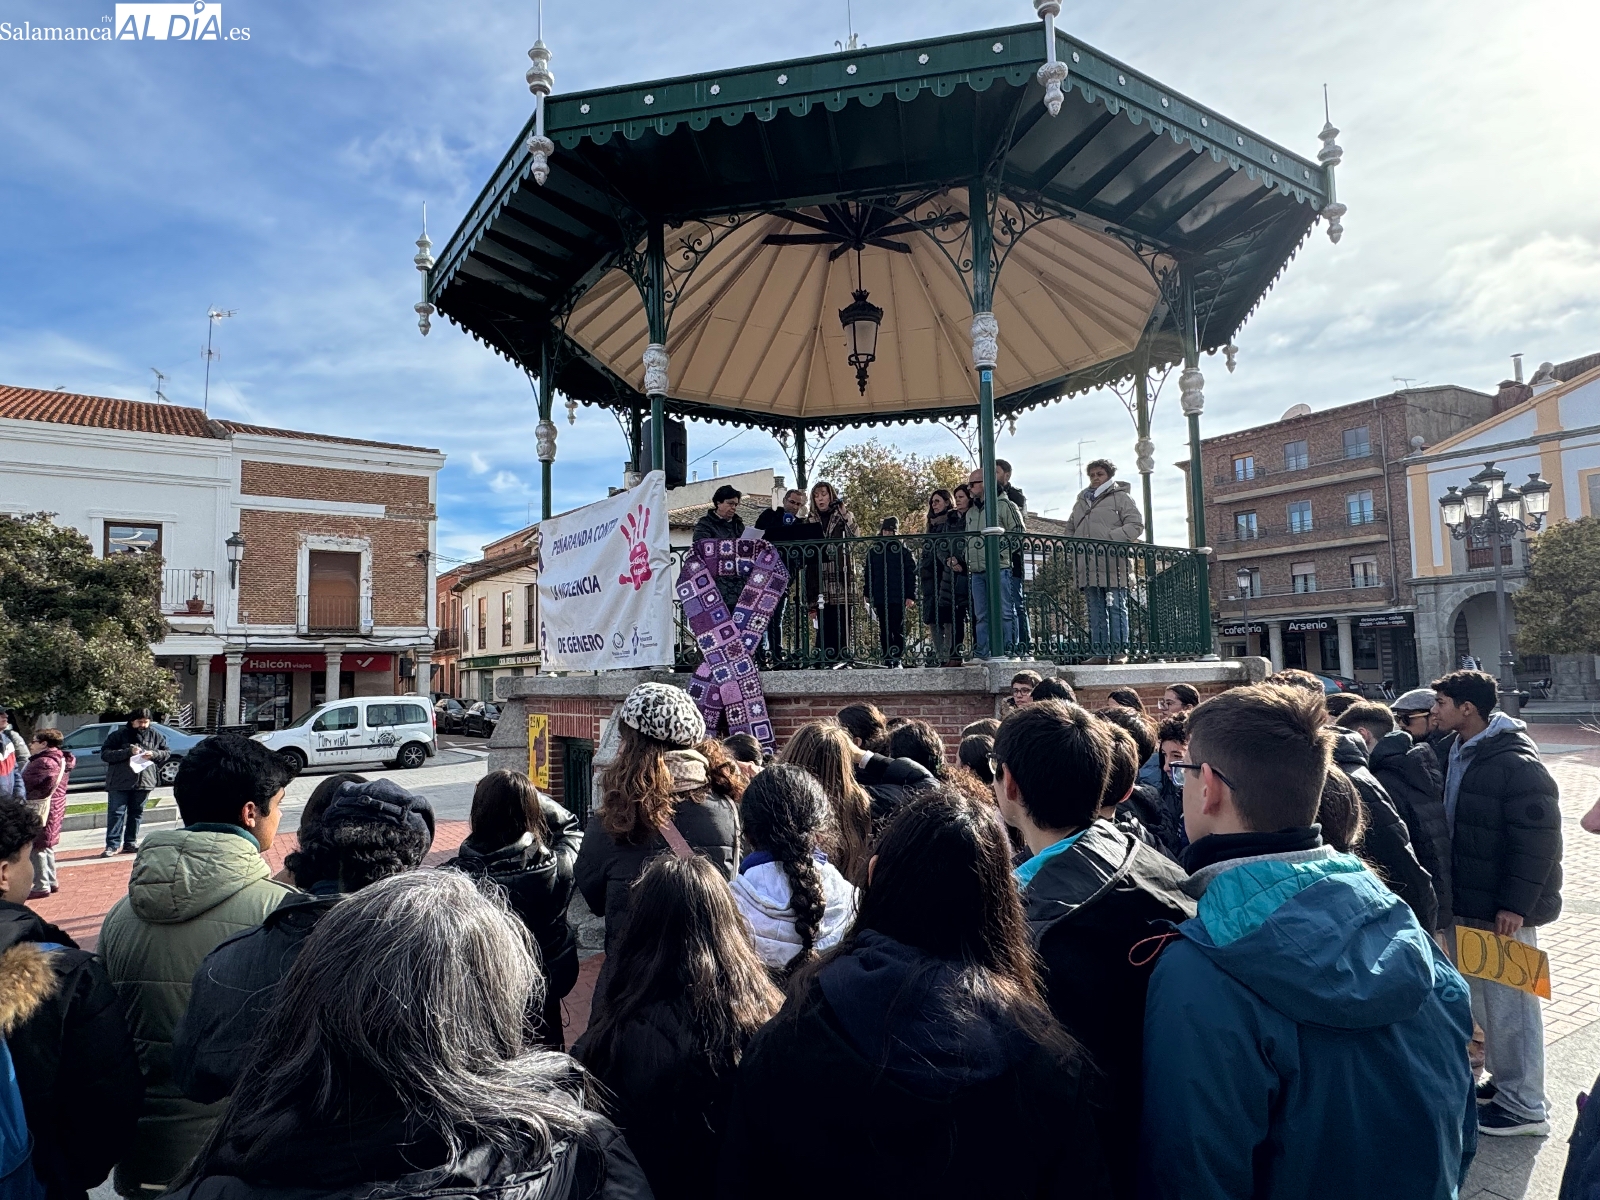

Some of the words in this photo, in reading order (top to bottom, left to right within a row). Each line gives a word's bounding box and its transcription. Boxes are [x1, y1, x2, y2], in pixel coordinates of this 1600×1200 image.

[551, 527, 593, 556] PEÑARANDA
[1288, 620, 1328, 631] Arsenio
[557, 637, 566, 654] DE
[566, 632, 605, 654] GÉNERO
[249, 659, 292, 669] Halcón
[292, 662, 312, 670] viajes
